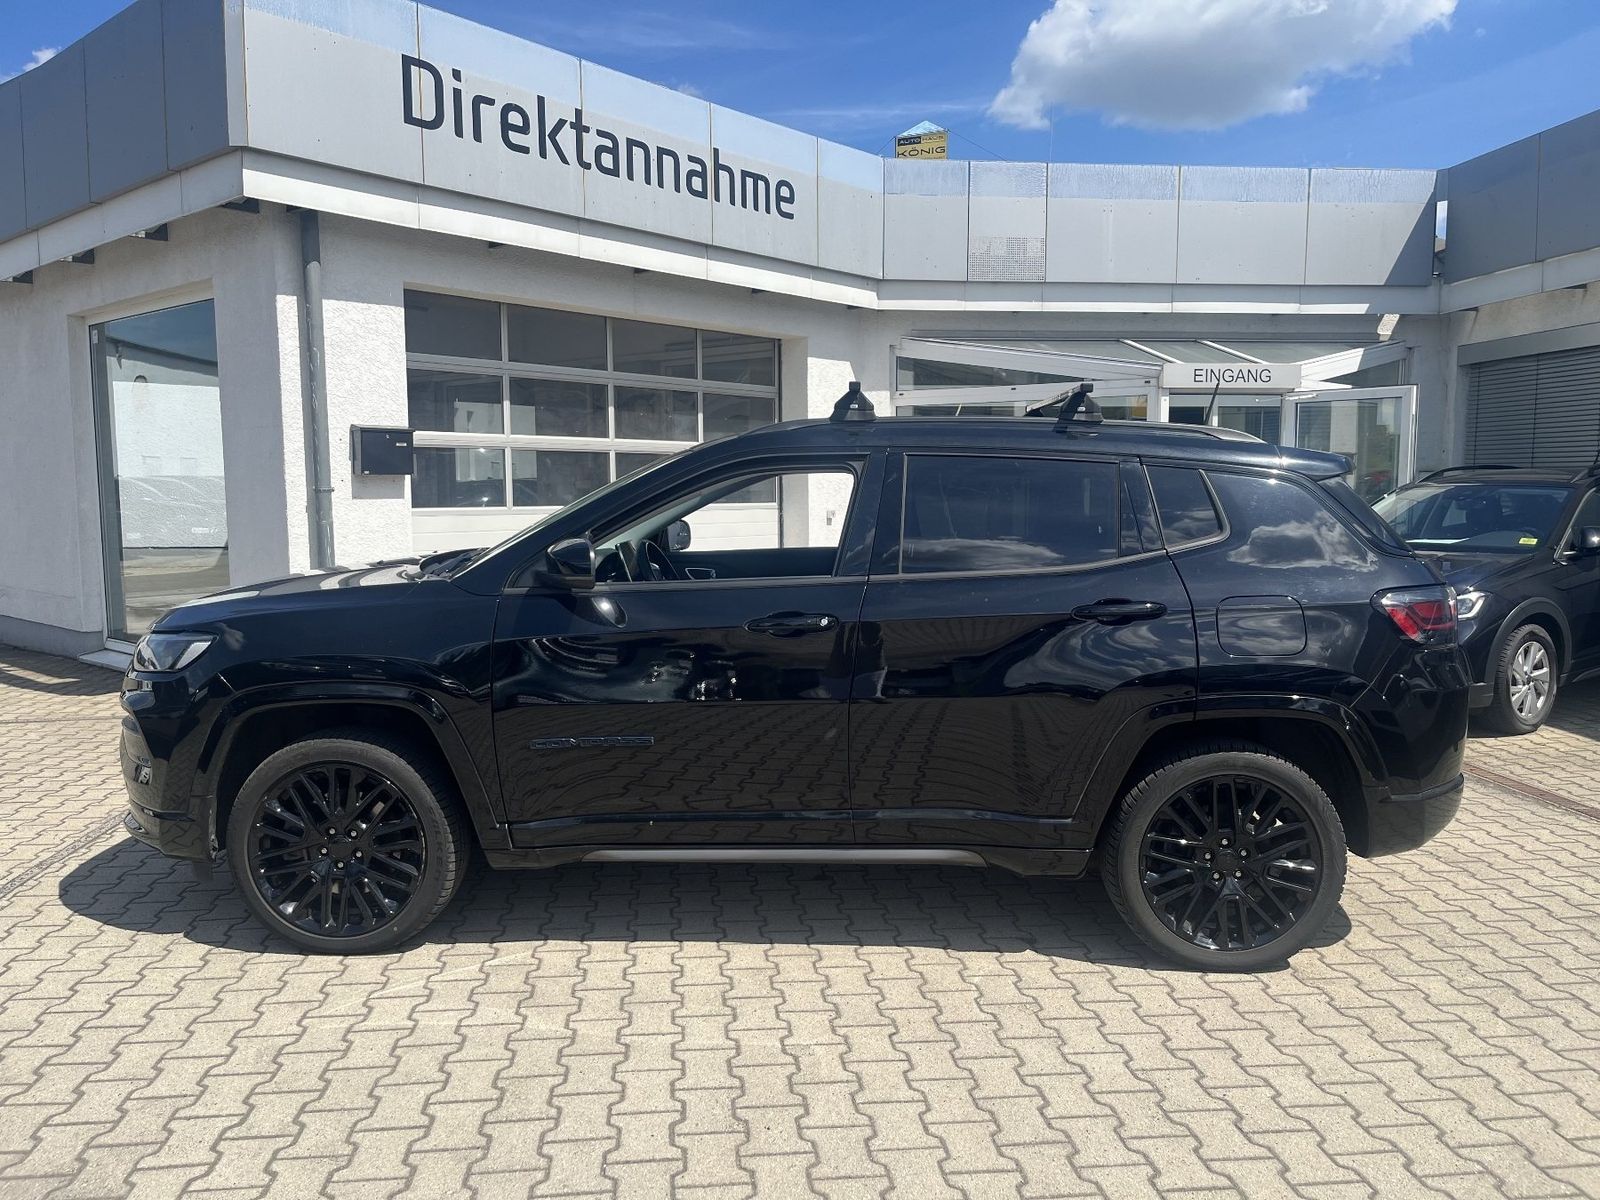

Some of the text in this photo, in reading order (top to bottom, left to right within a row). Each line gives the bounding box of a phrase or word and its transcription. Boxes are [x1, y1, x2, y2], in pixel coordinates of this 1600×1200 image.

[401, 54, 796, 220] Direktannahme
[897, 146, 946, 158] KÖNIG
[1193, 368, 1272, 383] EINGANG
